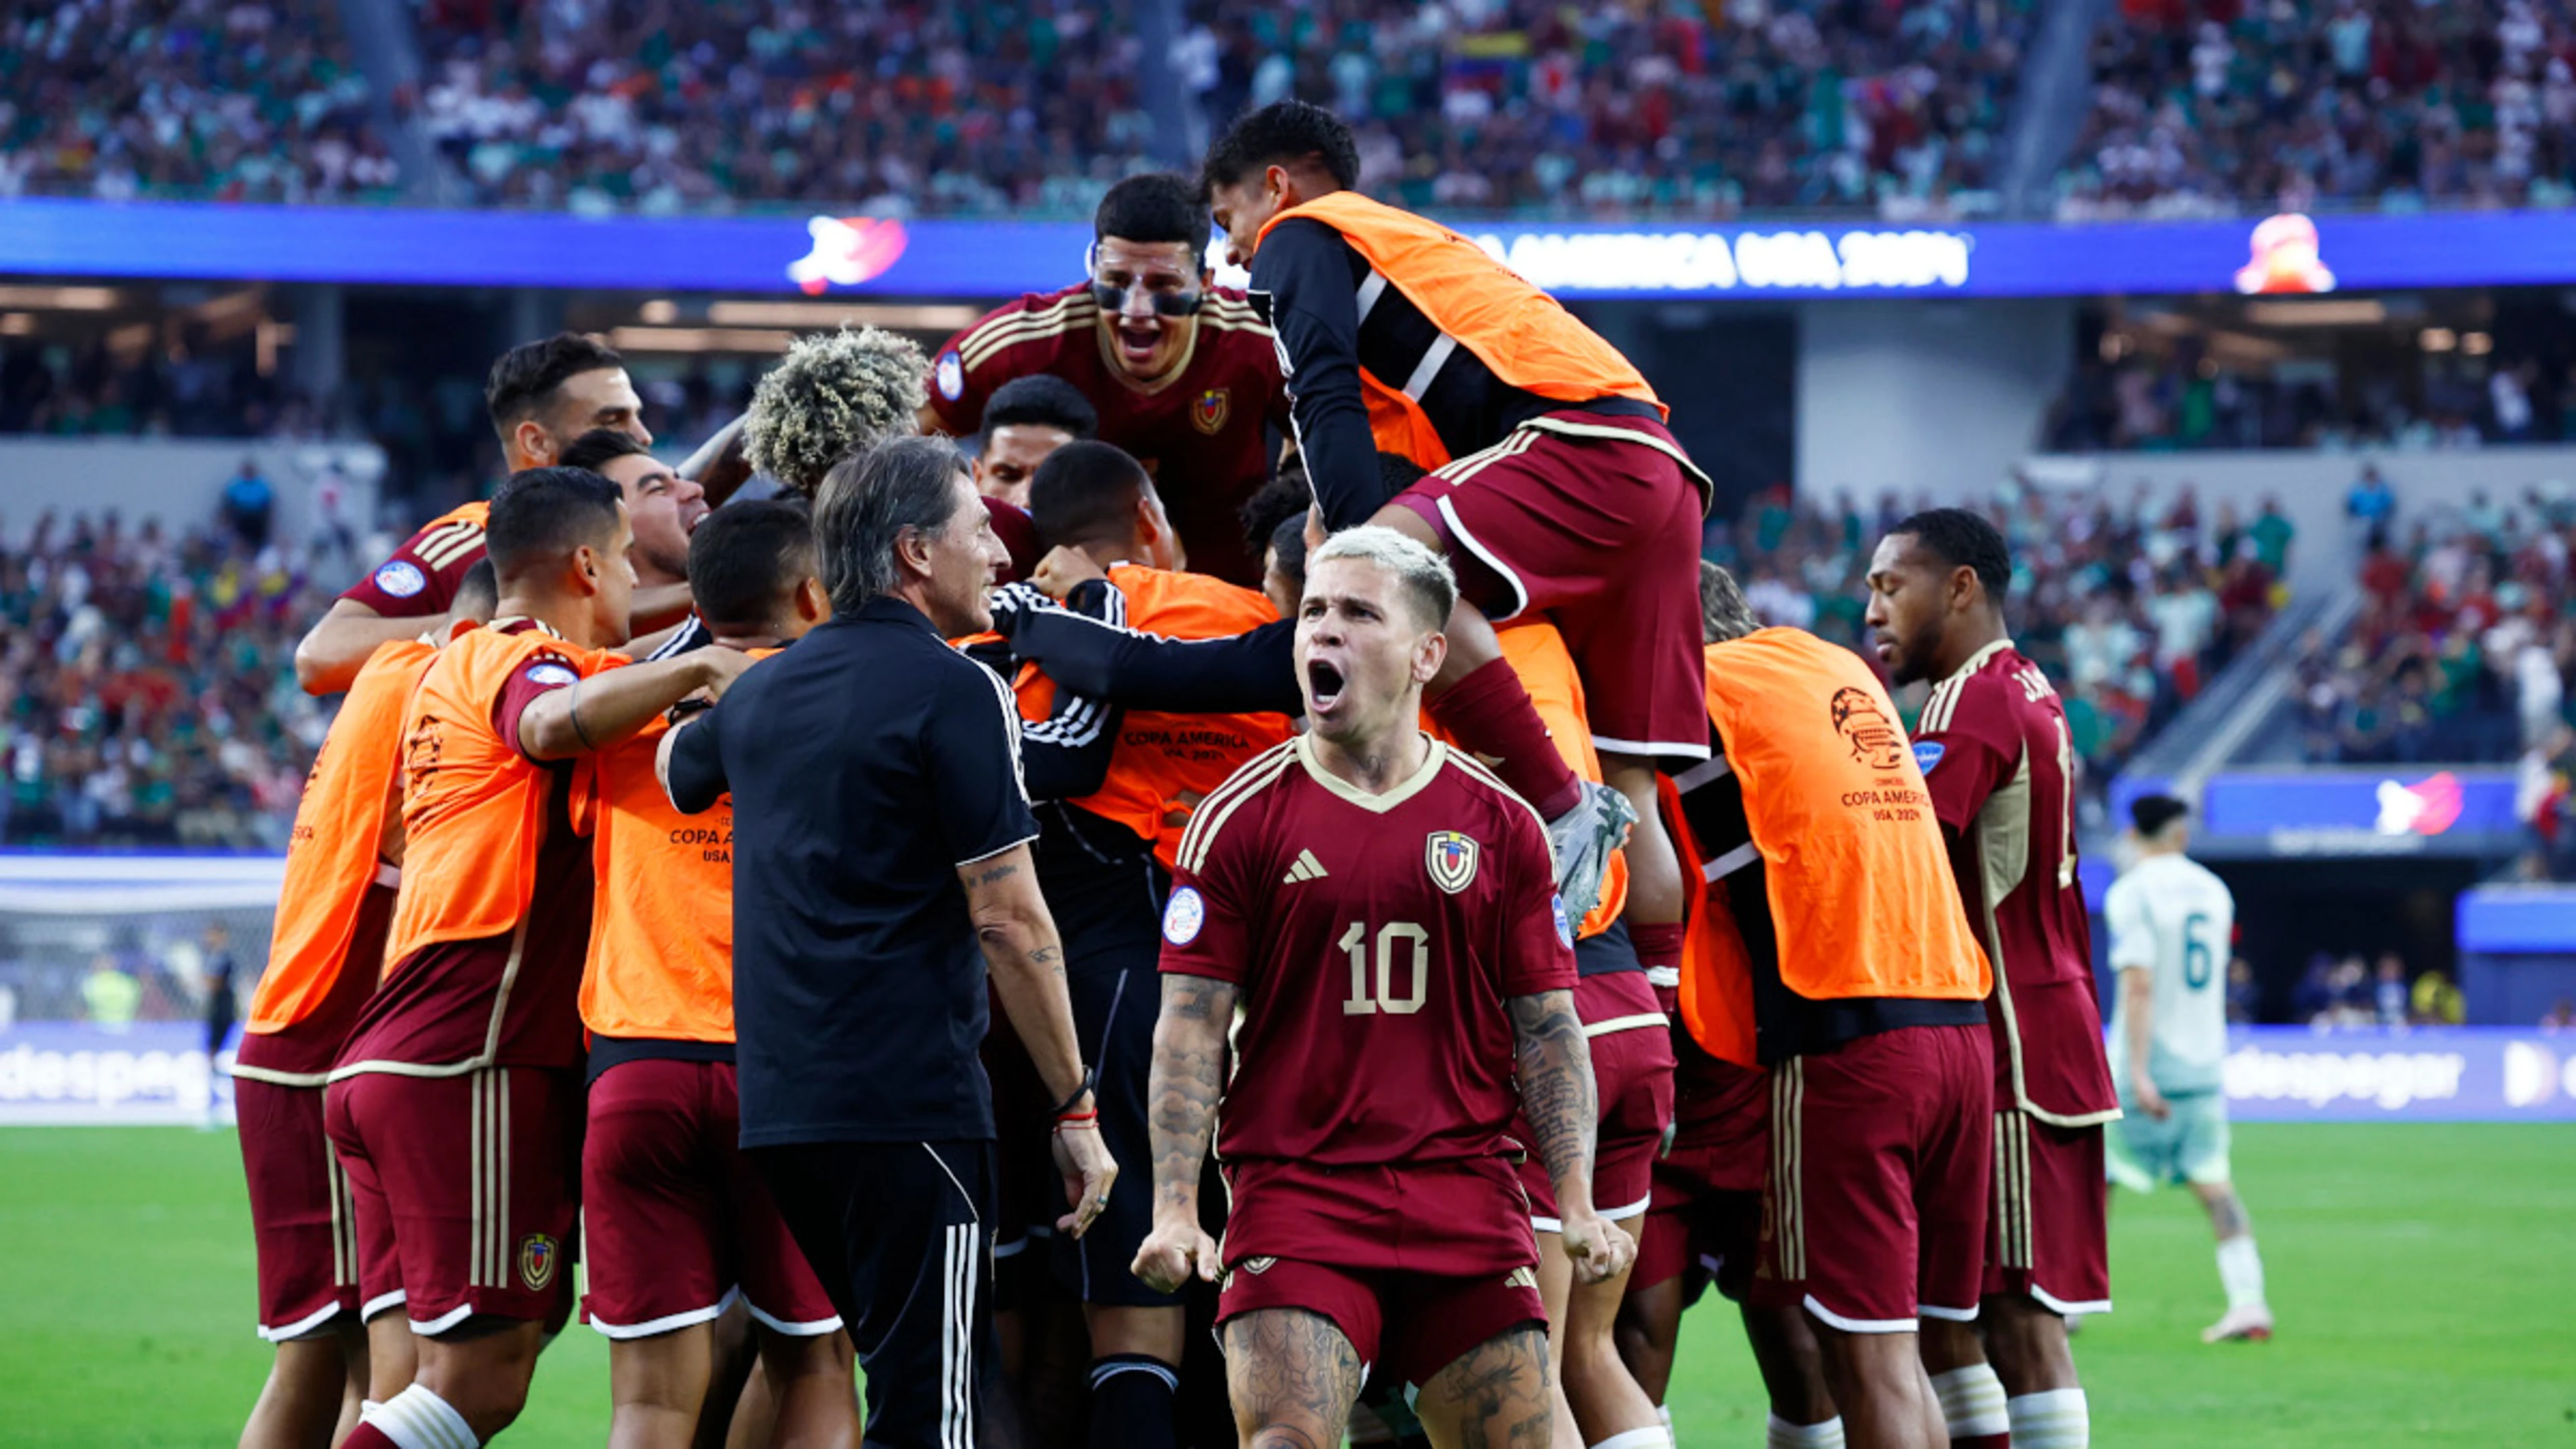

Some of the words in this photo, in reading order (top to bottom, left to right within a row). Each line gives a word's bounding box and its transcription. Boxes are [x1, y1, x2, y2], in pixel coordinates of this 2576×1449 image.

[1124, 731, 1173, 746] COPA
[1177, 731, 1250, 749] AMERICA
[1841, 791, 1880, 807] COPA
[1874, 809, 1894, 820] USA
[1896, 808, 1921, 820] 2024
[669, 828, 719, 844] COPA
[703, 849, 730, 863] USA
[2184, 912, 2213, 990] 6
[1338, 922, 1429, 1014] 10
